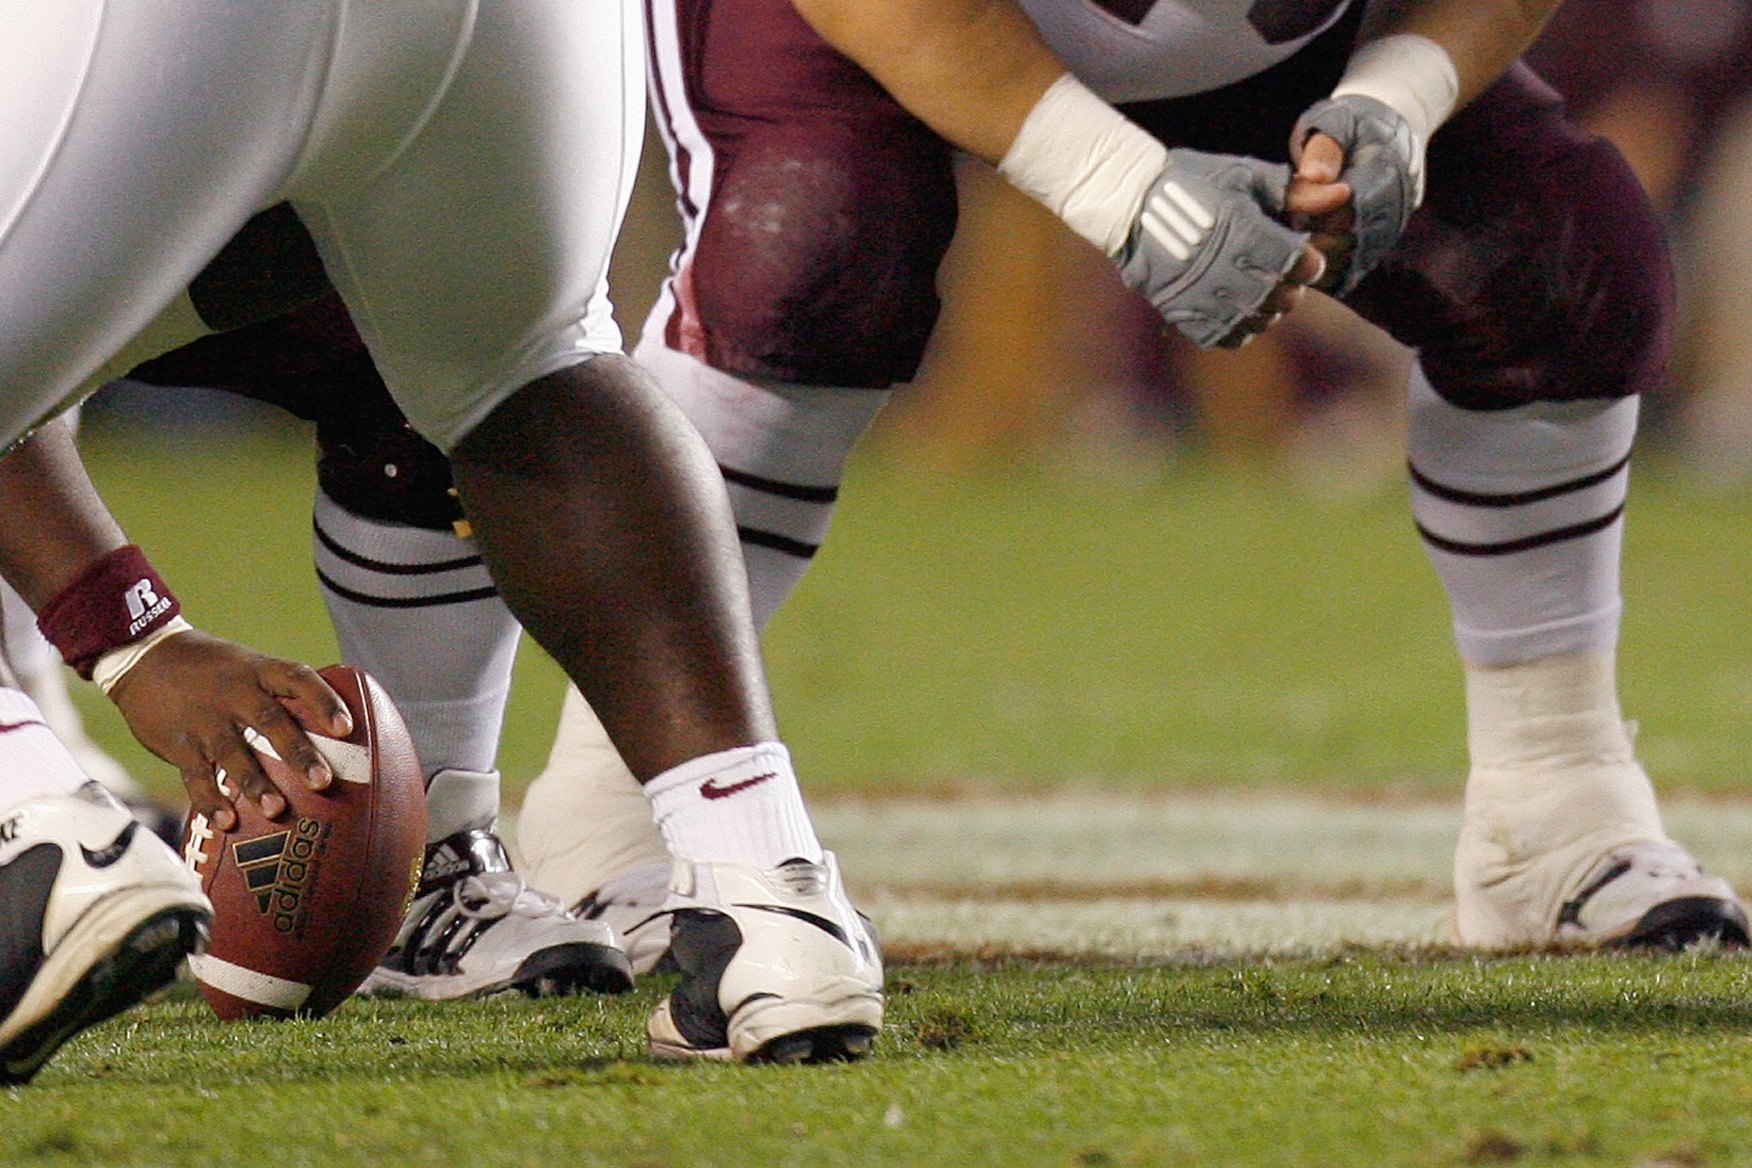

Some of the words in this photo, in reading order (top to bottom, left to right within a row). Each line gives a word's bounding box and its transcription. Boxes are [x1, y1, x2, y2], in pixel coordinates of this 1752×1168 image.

[125, 578, 158, 620] R
[130, 596, 172, 635] RUSSELL
[273, 816, 321, 935] adidas
